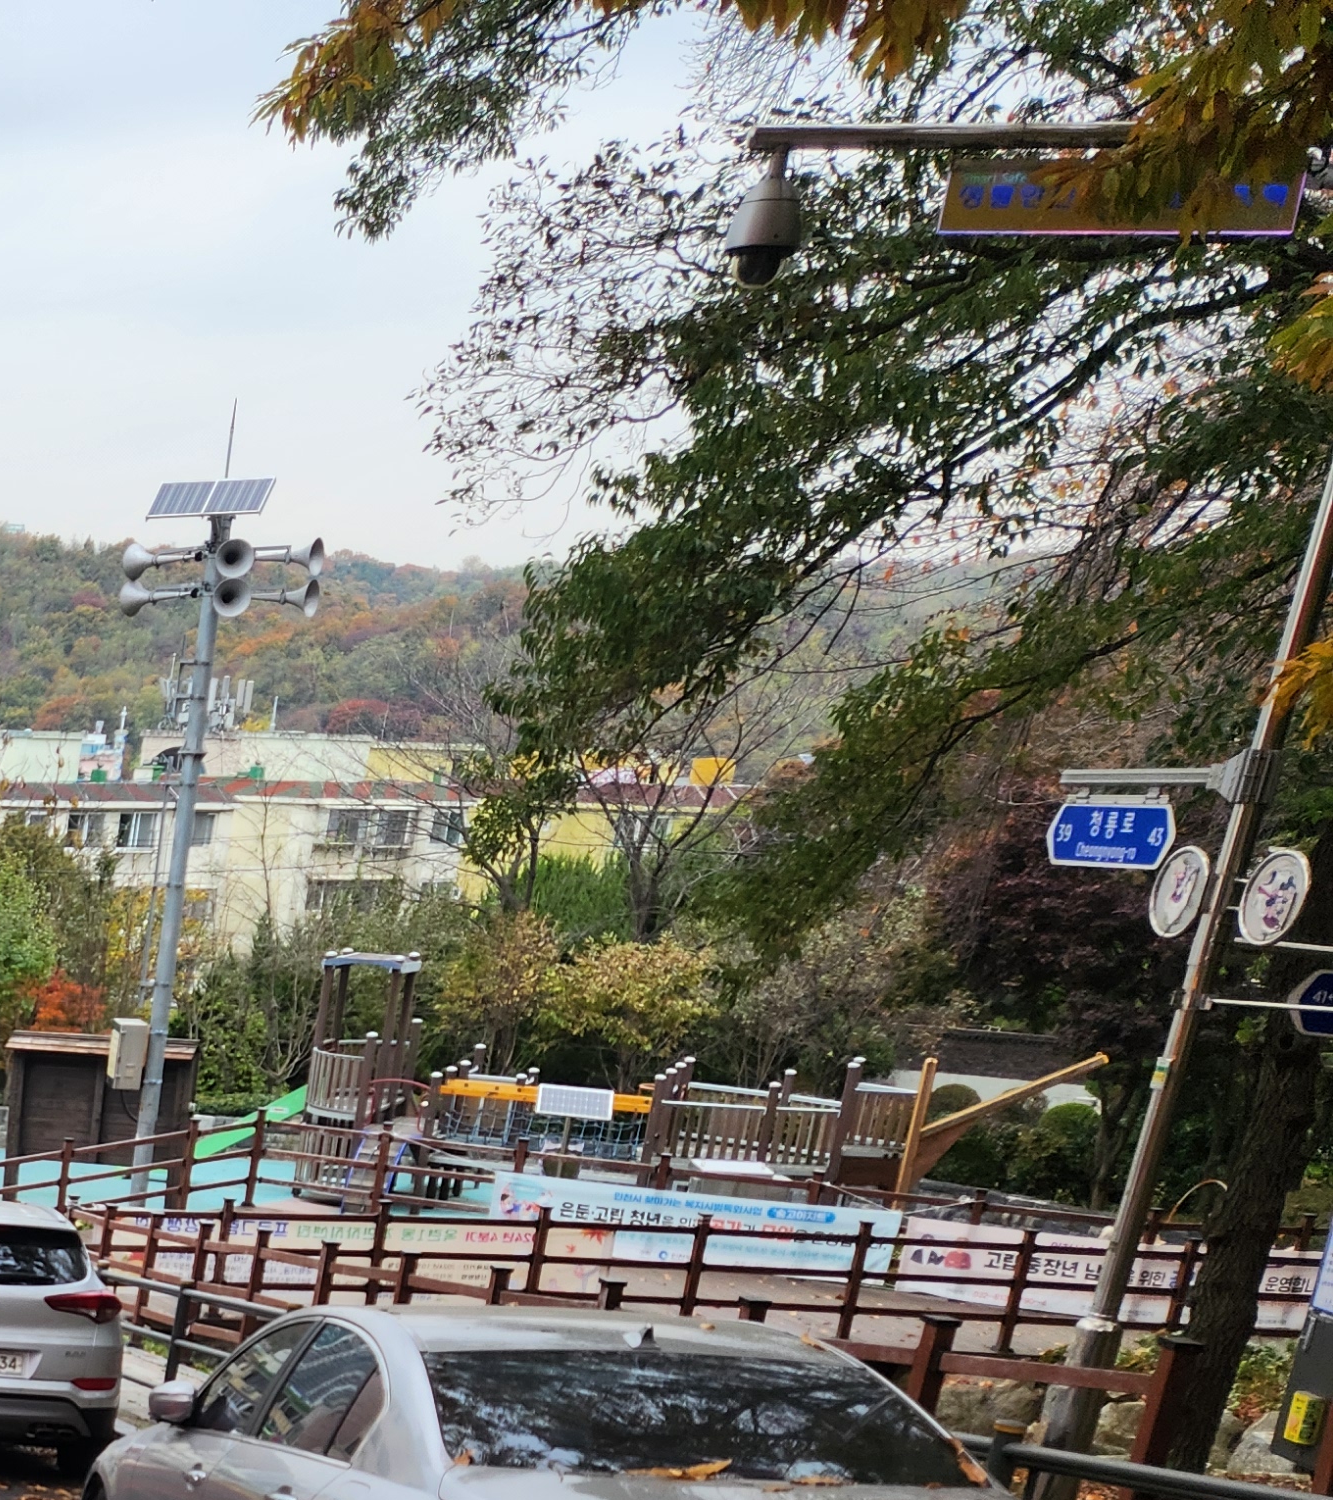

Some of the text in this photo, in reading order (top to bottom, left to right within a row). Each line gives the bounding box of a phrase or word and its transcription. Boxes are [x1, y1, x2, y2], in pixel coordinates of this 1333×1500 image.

[1056, 824, 1073, 842] 39
[1089, 810, 1136, 839] 청룡로
[1146, 827, 1165, 847] 43
[614, 1191, 642, 1203] 인천시
[984, 1252, 1017, 1272] 고립
[1137, 1270, 1167, 1288] 위한
